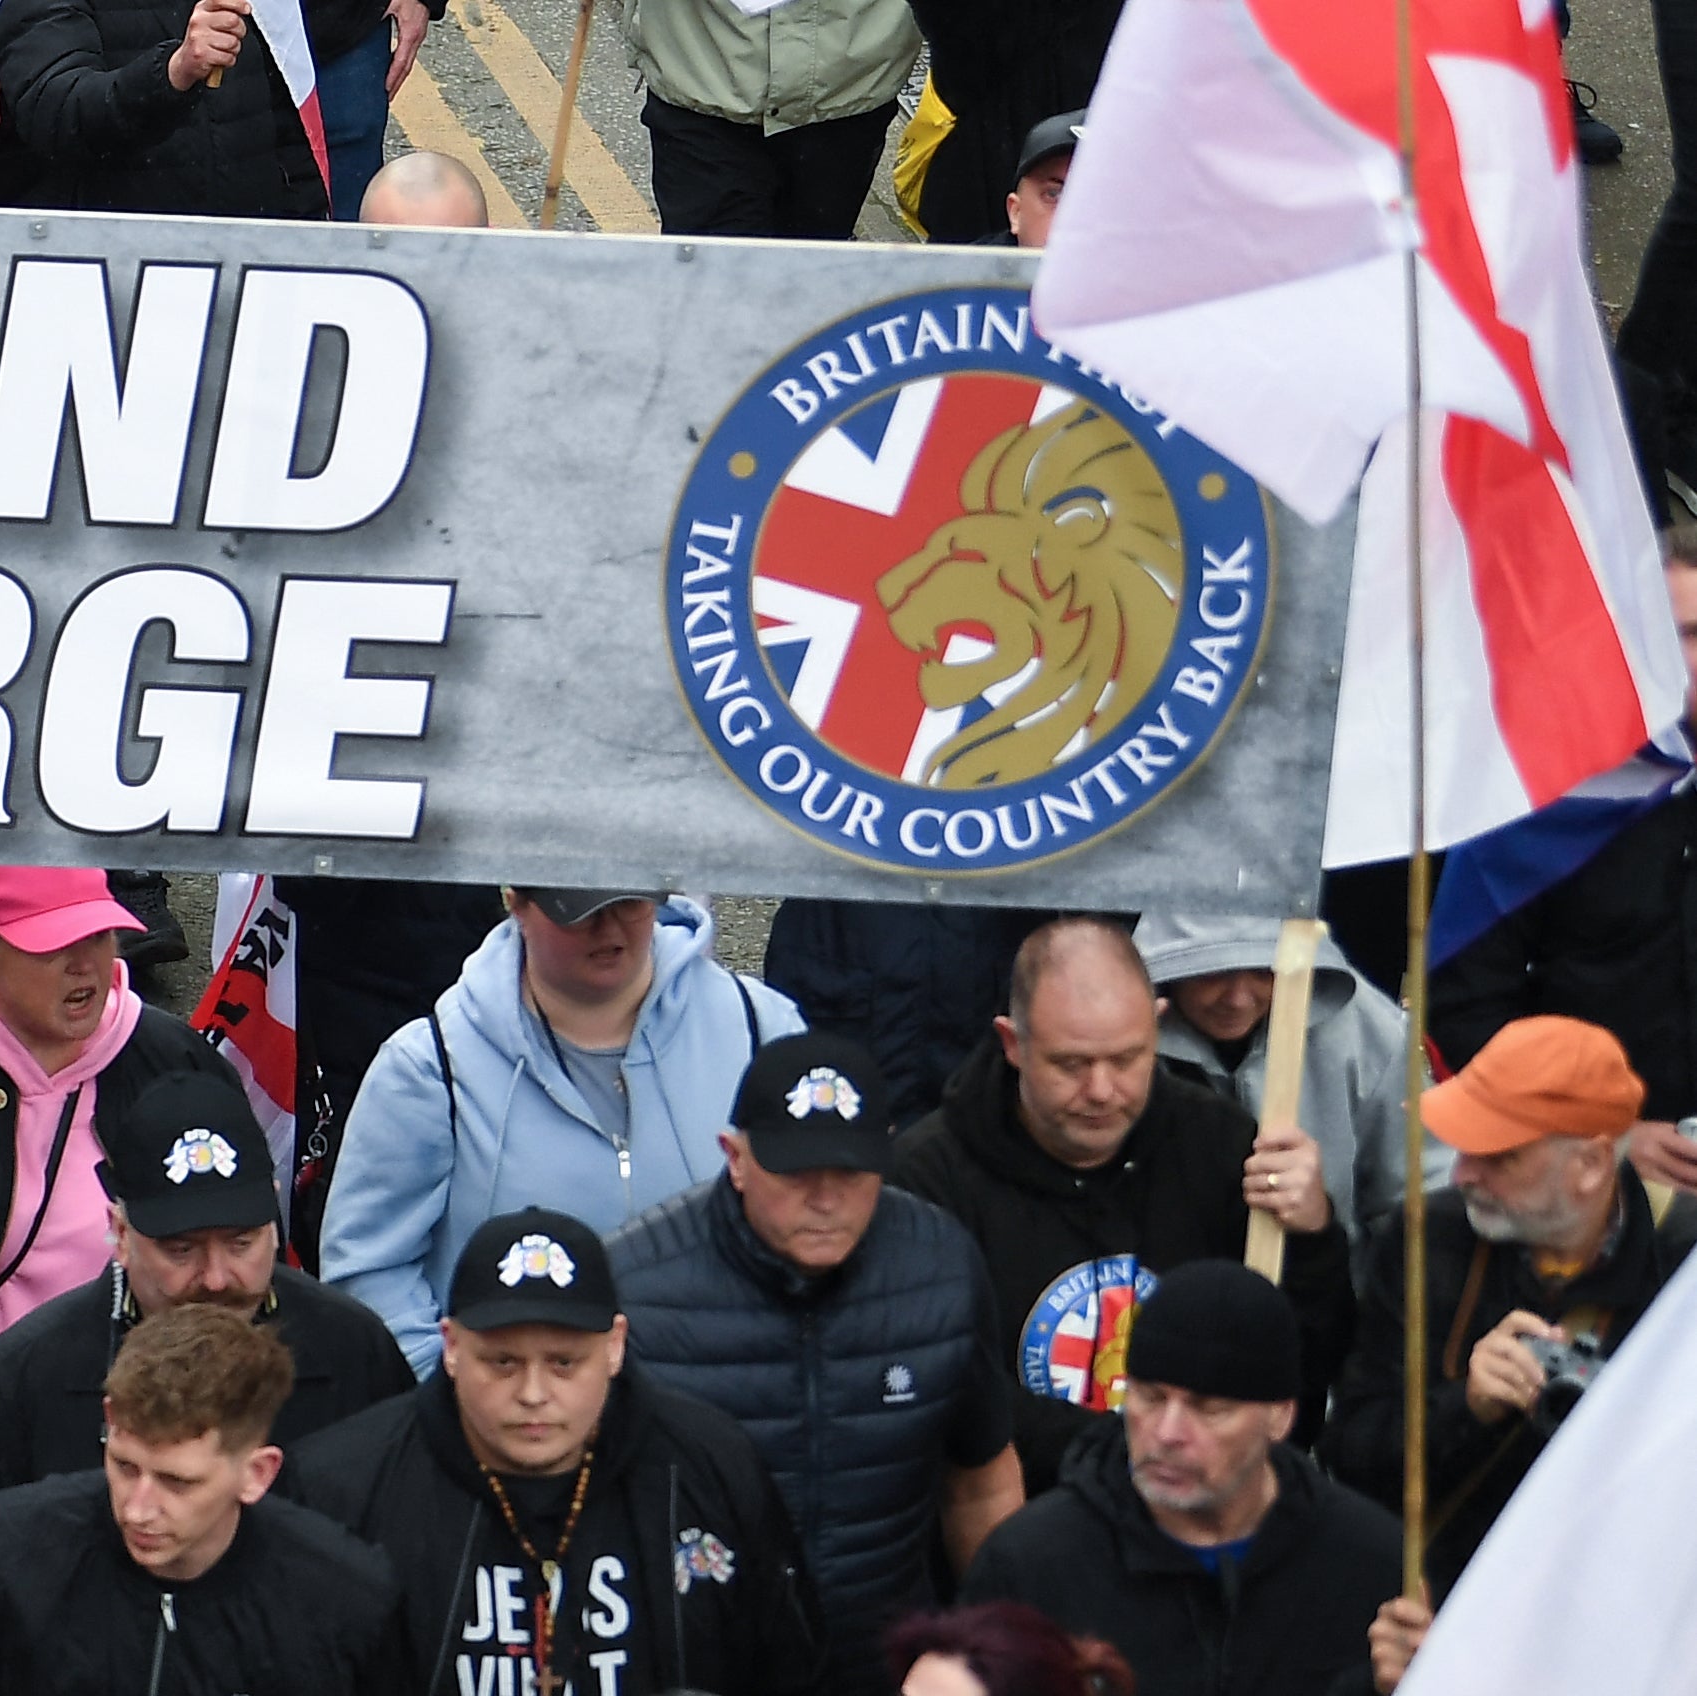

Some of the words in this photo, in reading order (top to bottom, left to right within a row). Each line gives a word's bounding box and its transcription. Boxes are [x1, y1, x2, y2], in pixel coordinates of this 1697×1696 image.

[768, 302, 1033, 425] BRITAIN
[682, 514, 774, 749] TAKING
[758, 743, 887, 848] OUR
[899, 703, 1195, 858] COUNTRY
[1173, 536, 1253, 707] BACK
